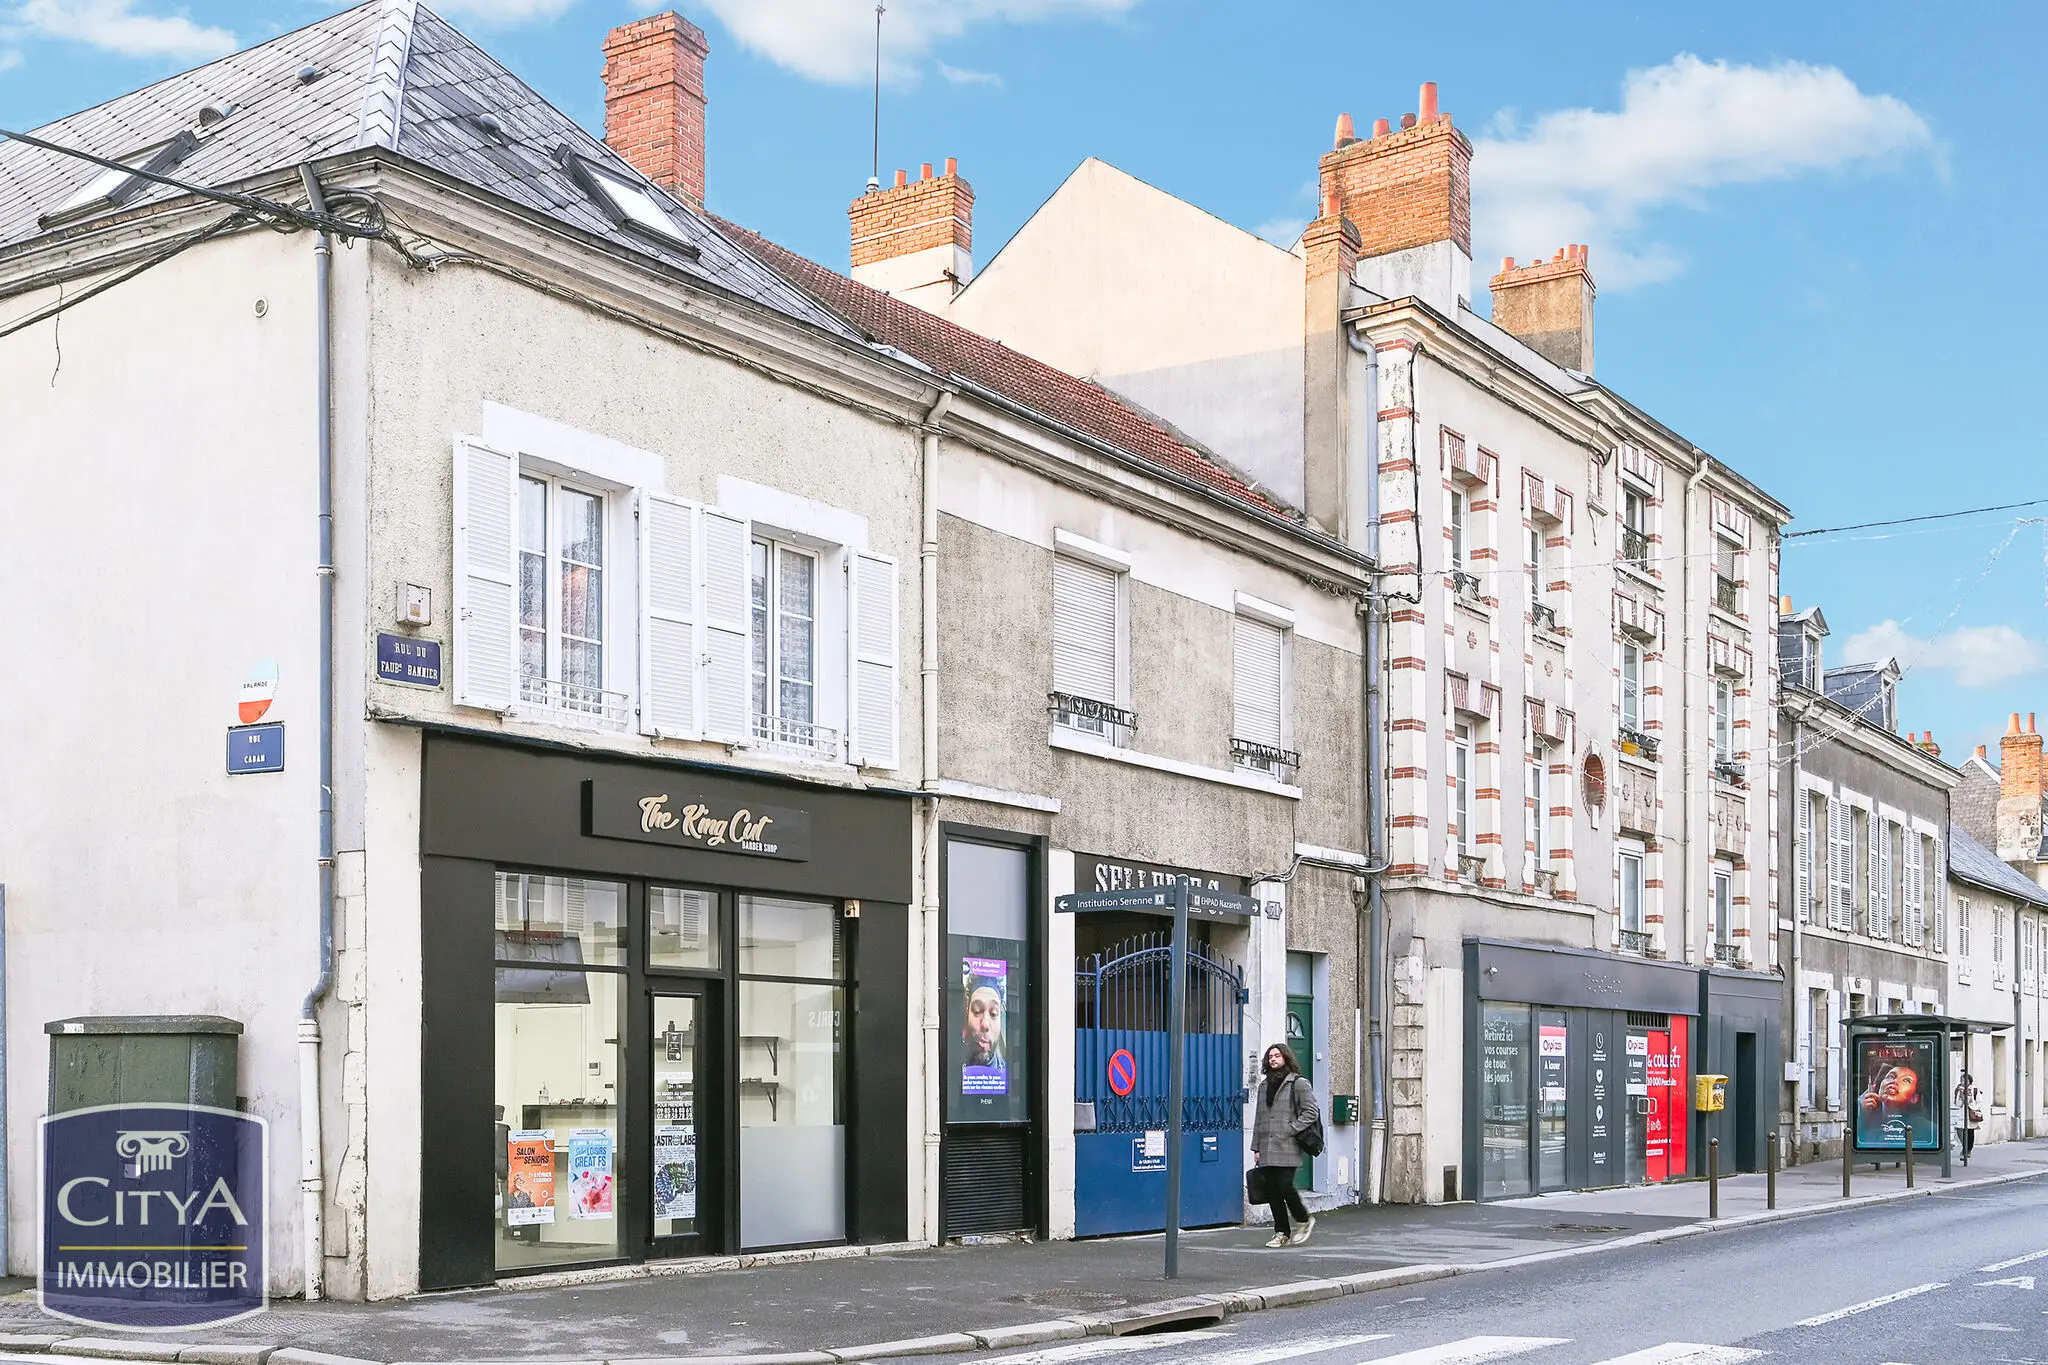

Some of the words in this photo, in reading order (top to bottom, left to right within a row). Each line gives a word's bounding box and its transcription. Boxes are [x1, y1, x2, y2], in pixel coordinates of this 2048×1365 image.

[395, 642, 411, 655] RUE
[416, 646, 427, 658] DU
[407, 664, 438, 680] BANNIER
[248, 734, 261, 744] RUE
[638, 794, 680, 833] The
[682, 804, 729, 846] King
[729, 809, 773, 843] Cut
[742, 840, 763, 852] BARBER
[763, 843, 778, 853] SHOP
[1077, 899, 1118, 908] Institution
[1120, 897, 1153, 906] Serenne
[1201, 896, 1219, 907] EHPAD
[1219, 899, 1242, 910] Nazareth
[1484, 1029, 1505, 1041] Retirez
[1484, 1046, 1495, 1055] vos
[1496, 1046, 1518, 1055] courses
[1484, 1057, 1492, 1069] de
[1493, 1058, 1507, 1069] tous
[1549, 1060, 1561, 1070] louer
[1633, 1058, 1644, 1068] louer
[1653, 1054, 1681, 1068] COLLECT
[1484, 1070, 1494, 1083] les
[516, 1147, 535, 1156] SALON
[524, 1155, 549, 1164] SENIORS
[574, 1155, 607, 1168] CREATFS
